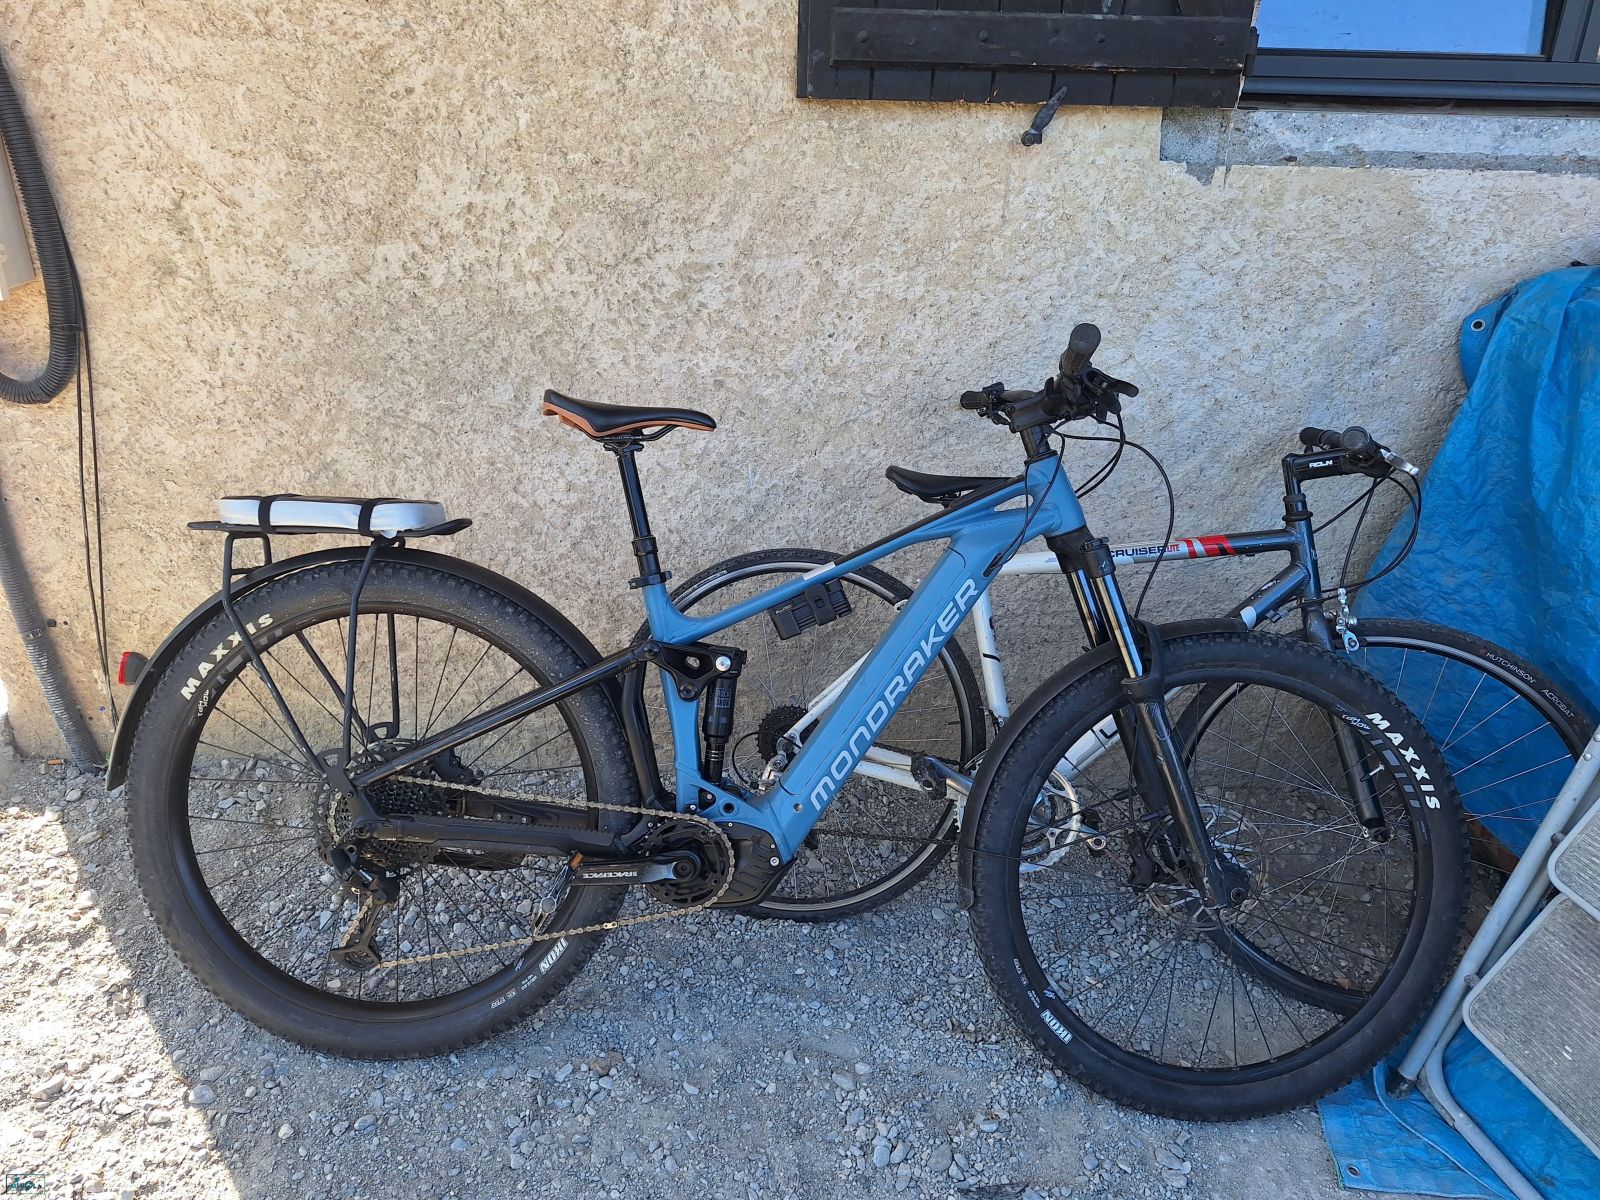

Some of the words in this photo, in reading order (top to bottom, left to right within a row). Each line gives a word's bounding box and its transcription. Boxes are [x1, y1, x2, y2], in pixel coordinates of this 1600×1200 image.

[181, 613, 274, 701] MAXXIS
[1486, 652, 1536, 684] HUTCHINSON
[1541, 689, 1575, 718] ACROBAT
[1365, 712, 1441, 809] MAXXIS
[539, 937, 569, 975] IKON
[1040, 1009, 1073, 1044] IKON
